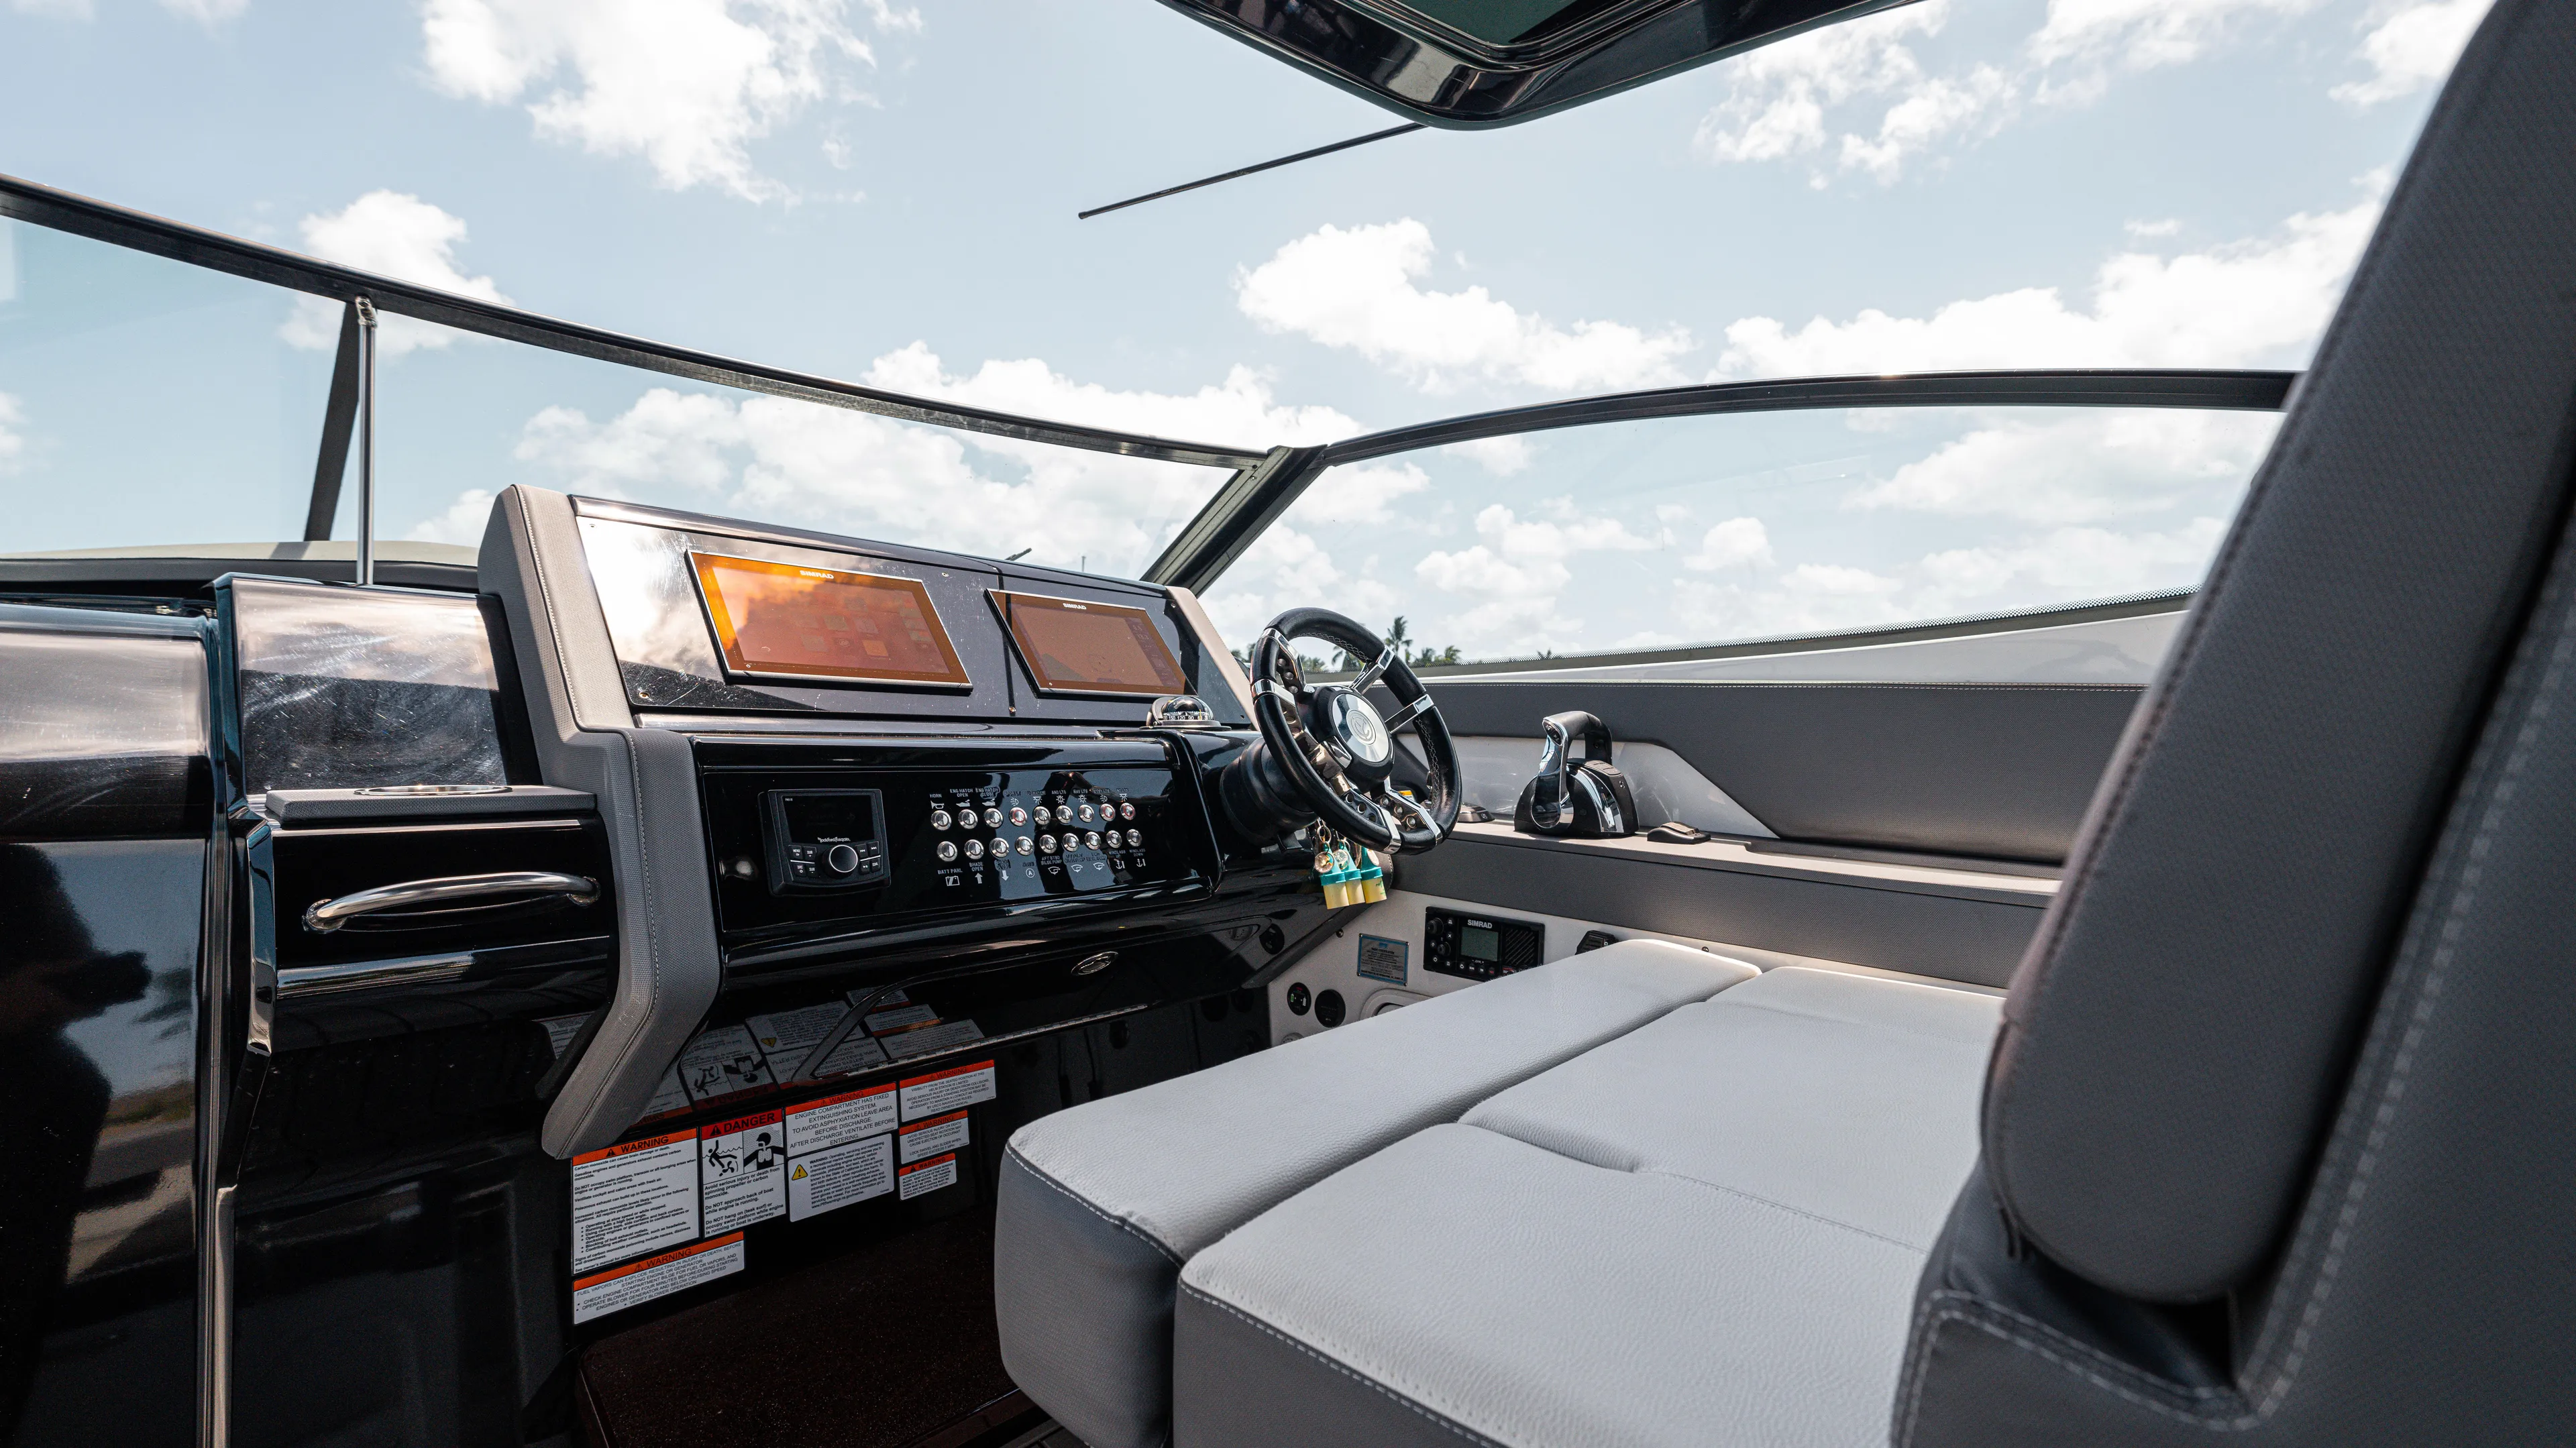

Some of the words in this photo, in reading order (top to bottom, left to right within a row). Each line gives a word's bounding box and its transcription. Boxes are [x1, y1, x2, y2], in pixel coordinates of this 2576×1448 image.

[800, 570, 834, 579] SIMRAD
[1468, 920, 1493, 929] SIMRAD
[936, 1067, 967, 1078] WARNING
[795, 1109, 816, 1119] ENGINE
[818, 1099, 859, 1114] COMPARTMENT
[873, 1093, 888, 1101] FIXED
[830, 1091, 863, 1104] WARNING
[724, 1112, 774, 1132] DANGER
[801, 1123, 818, 1131] AVOID
[820, 1113, 859, 1127] ASPHYXIATION
[861, 1109, 877, 1117] LEAVE
[878, 1105, 892, 1113] AREA
[809, 1108, 853, 1123] EXTINGUISHING
[923, 1115, 953, 1127] WARNING
[790, 1139, 808, 1148] AFTER
[810, 1130, 843, 1144] DISCHARGE
[844, 1123, 873, 1134] VENTILATE
[874, 1117, 895, 1127] BEFORE
[814, 1125, 837, 1135] BEFORE
[621, 1135, 669, 1154] WARNING
[589, 1160, 608, 1168] monoxide
[918, 1157, 945, 1169] WARNING
[704, 1186, 724, 1196] spinning
[725, 1180, 746, 1190] propeller
[752, 1174, 768, 1182] carbon
[718, 1178, 736, 1186] serious
[718, 1203, 734, 1211] engine
[724, 1194, 745, 1205] approach
[705, 1221, 722, 1231] occupy
[723, 1217, 736, 1225] swim
[737, 1211, 755, 1221] platform
[768, 1203, 784, 1212] engine
[710, 1224, 729, 1233] running
[646, 1247, 691, 1268] WARNING
[576, 1288, 589, 1296] FUEL
[591, 1282, 612, 1292] VAPORS
[612, 1278, 623, 1286] CAN
[625, 1271, 647, 1282] EXPLODE
[648, 1262, 675, 1274] RESULTING
[682, 1255, 698, 1264] INJURY
[723, 1242, 741, 1251] BEFORE
[582, 1298, 606, 1311] OPERATE
[606, 1291, 629, 1302] BLOWER
[641, 1283, 655, 1291] FOUR
[655, 1276, 677, 1287] MINUTES
[716, 1257, 737, 1268] STARTING
[583, 1295, 601, 1304] CHECK
[602, 1288, 622, 1298] ENGINE
[623, 1276, 659, 1292] COMPARTMENT
[661, 1272, 675, 1280] BILGE
[596, 1299, 619, 1311] ENGINES
[629, 1286, 658, 1300] GENERATOR
[670, 1278, 687, 1287] BELOW
[688, 1270, 710, 1281] CRUISING
[710, 1265, 726, 1274] SPEED
[621, 1276, 645, 1288] STARTING
[646, 1270, 665, 1280] ENGINE
[629, 1295, 647, 1304] VERIFY
[648, 1288, 669, 1298] BLOWER
[669, 1279, 696, 1292] OPERATION
